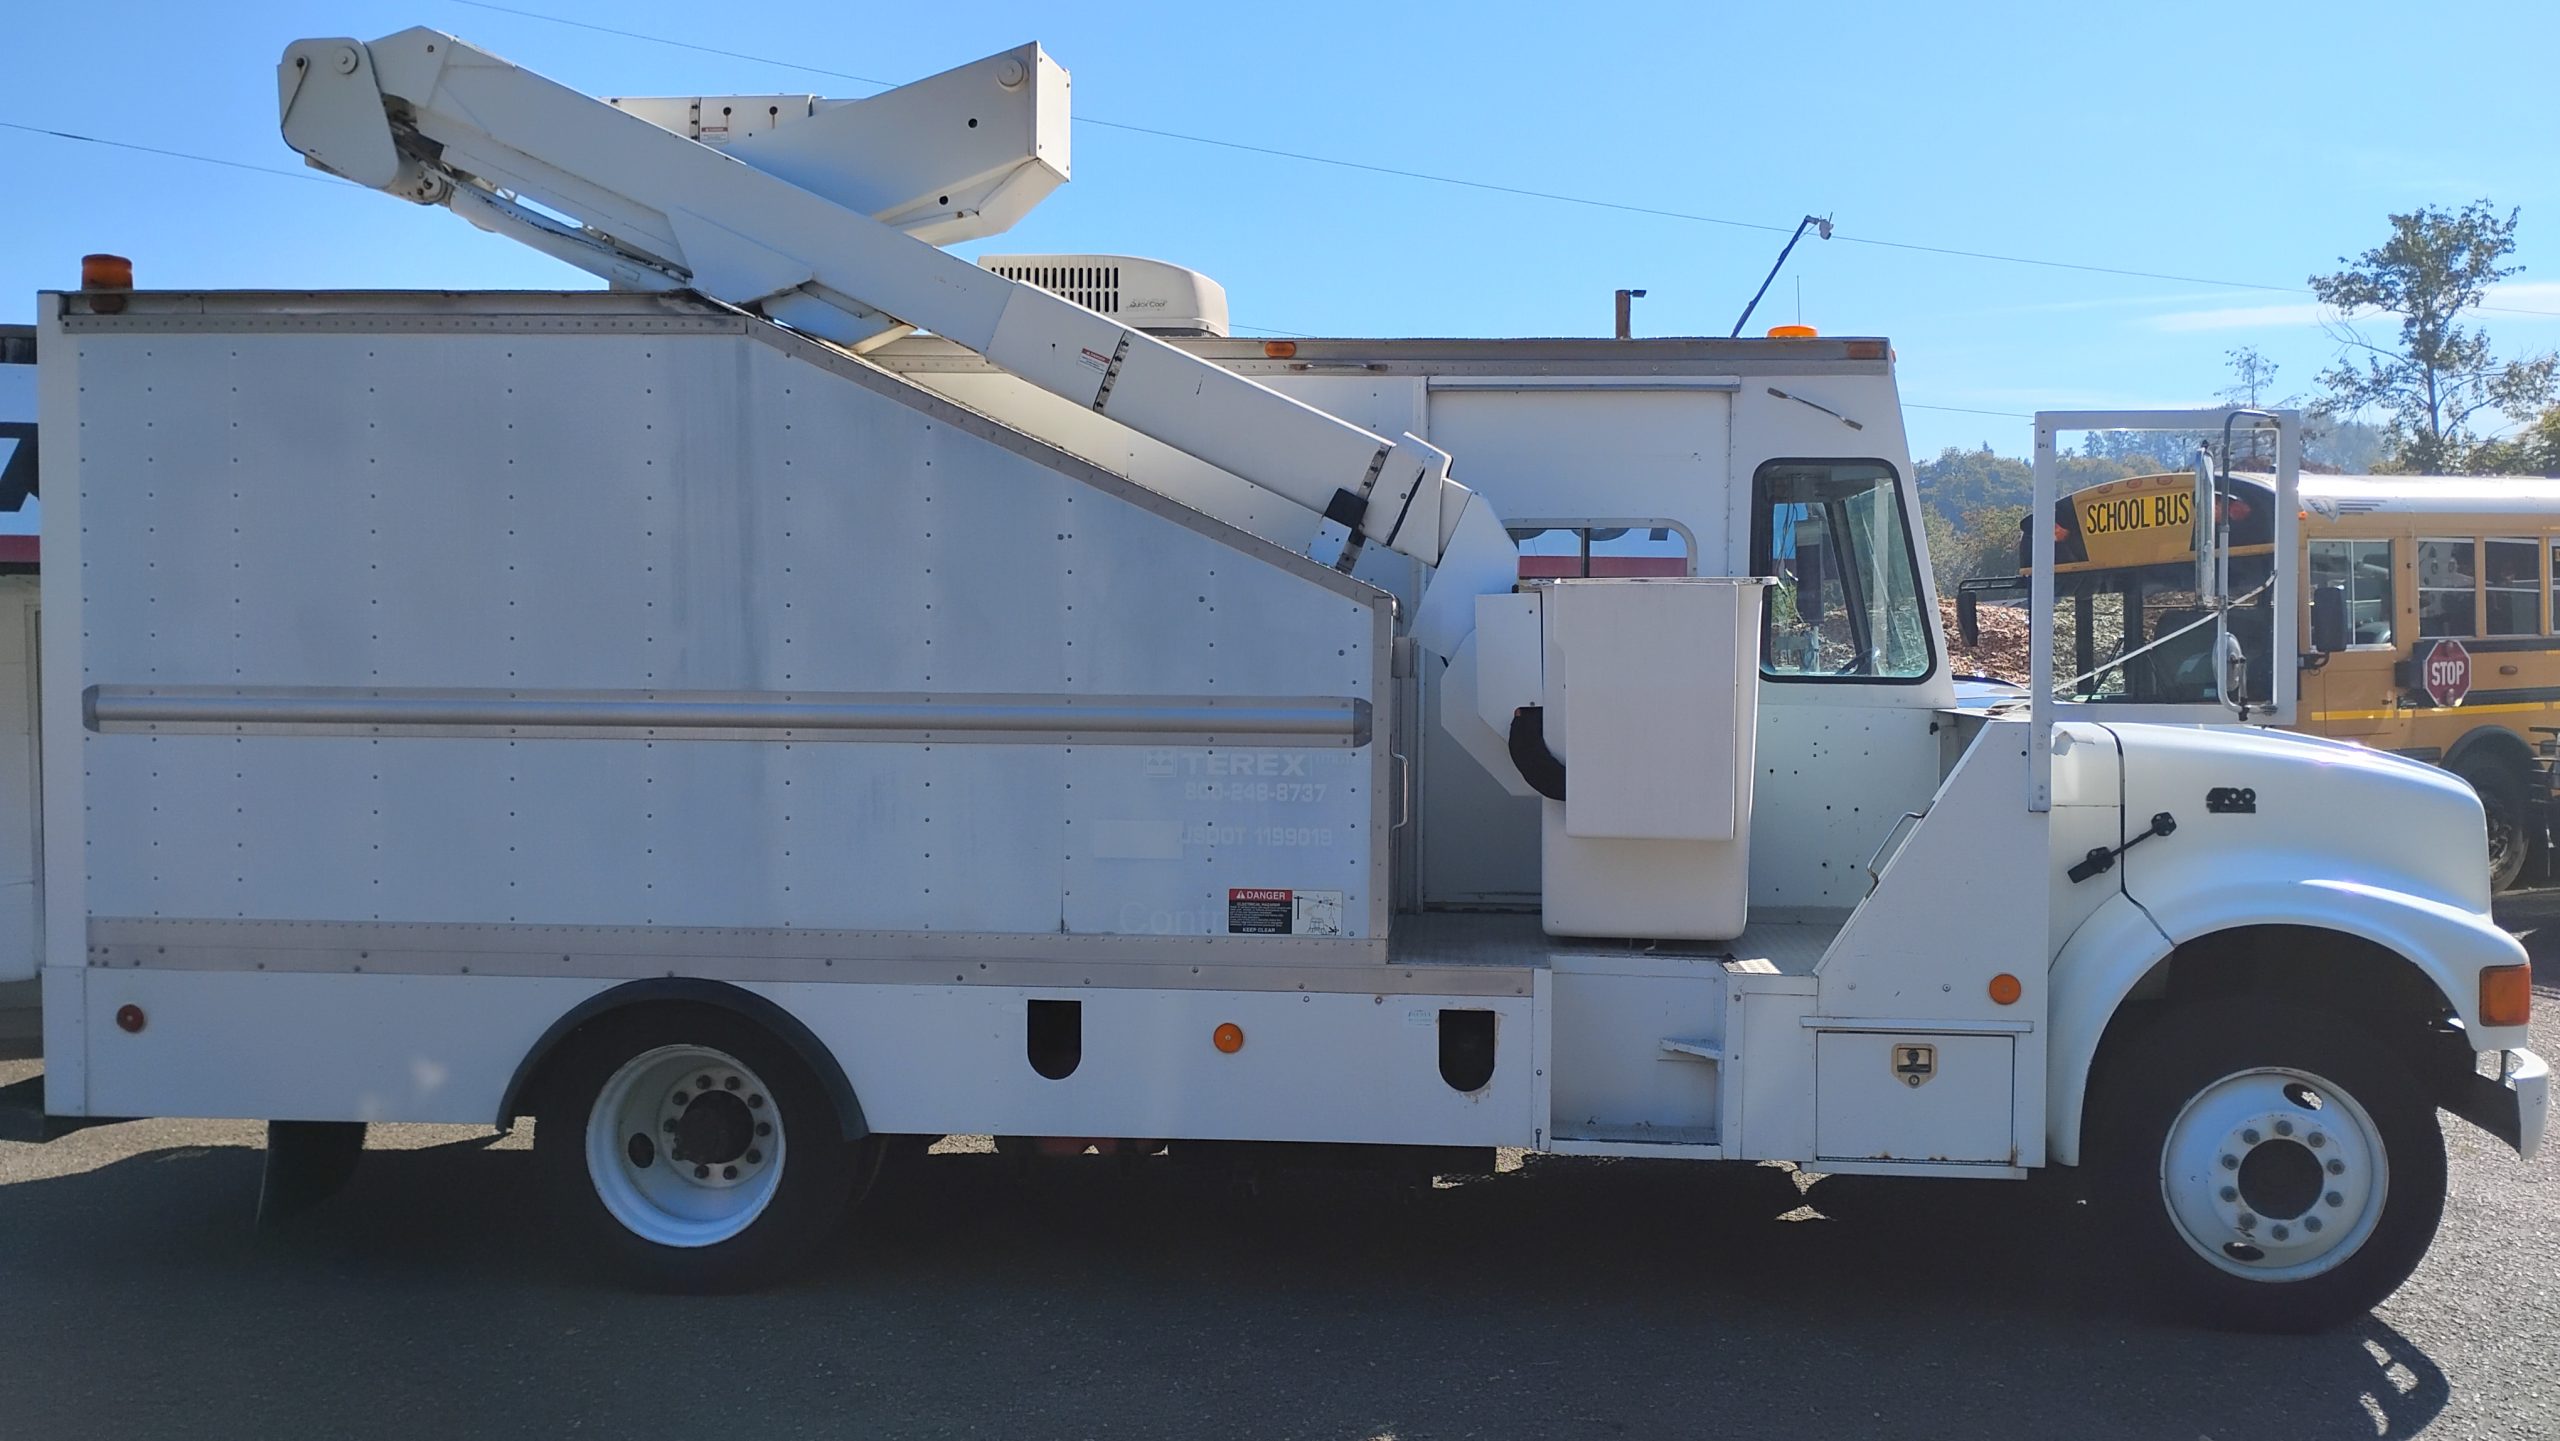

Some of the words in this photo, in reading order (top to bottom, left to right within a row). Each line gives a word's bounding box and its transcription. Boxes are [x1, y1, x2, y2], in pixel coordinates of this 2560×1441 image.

[2087, 498, 2151, 534] SCHOOL
[2155, 493, 2190, 526] BUS
[2431, 661, 2465, 686] STOP
[1182, 753, 1306, 777] TEREX
[1185, 782, 1328, 803] 800-248-8737
[1246, 890, 1286, 900] DANGER
